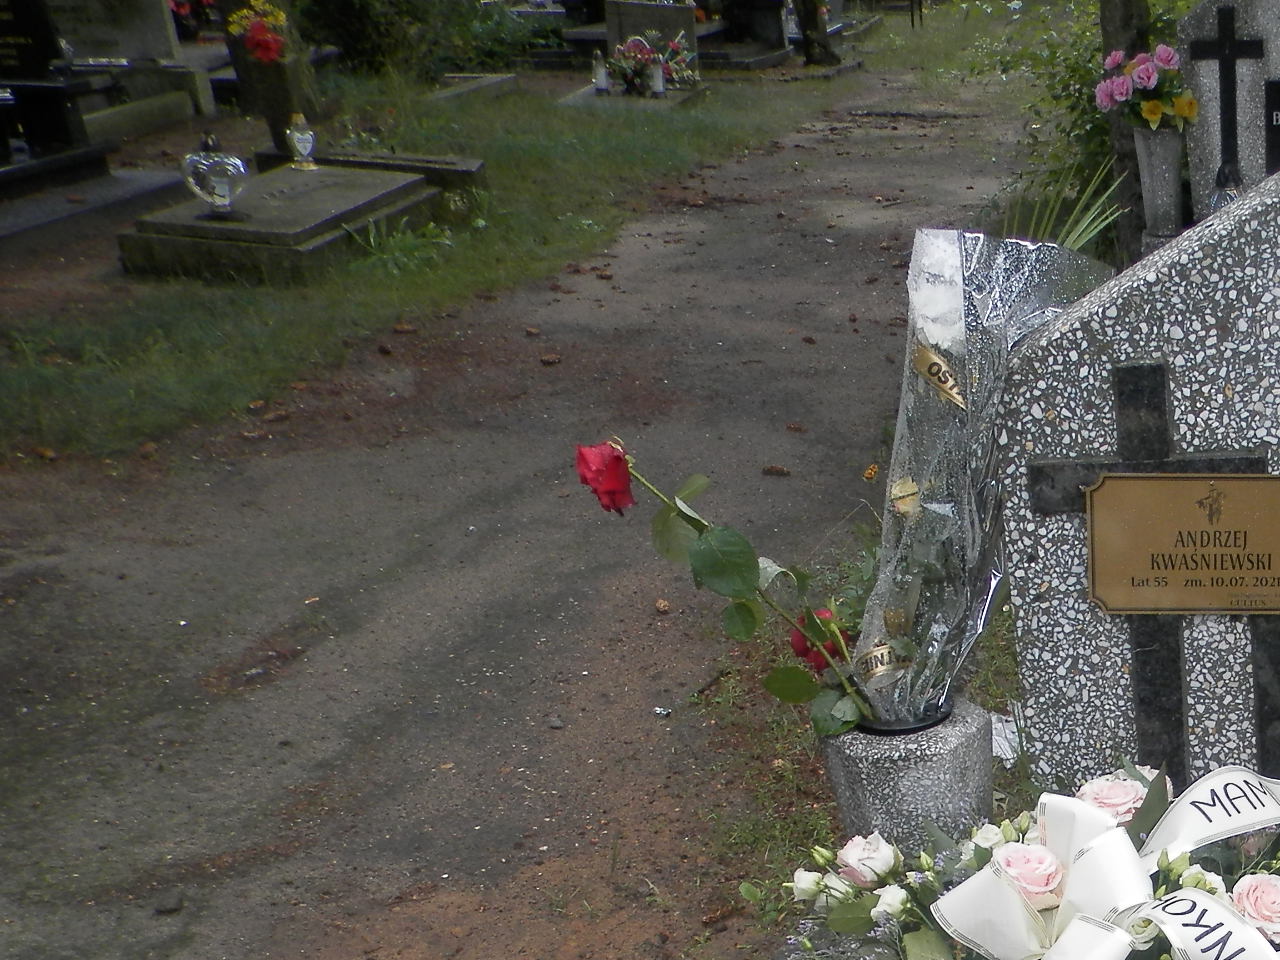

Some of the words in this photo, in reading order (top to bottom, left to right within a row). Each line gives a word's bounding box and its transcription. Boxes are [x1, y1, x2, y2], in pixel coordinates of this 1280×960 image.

[1174, 530, 1248, 550] ANDRZEJ
[1150, 548, 1273, 572] KWAŚNIEWSKI
[1130, 576, 1151, 588] Lat
[1153, 576, 1169, 588] 55
[1183, 577, 1206, 588] zm.
